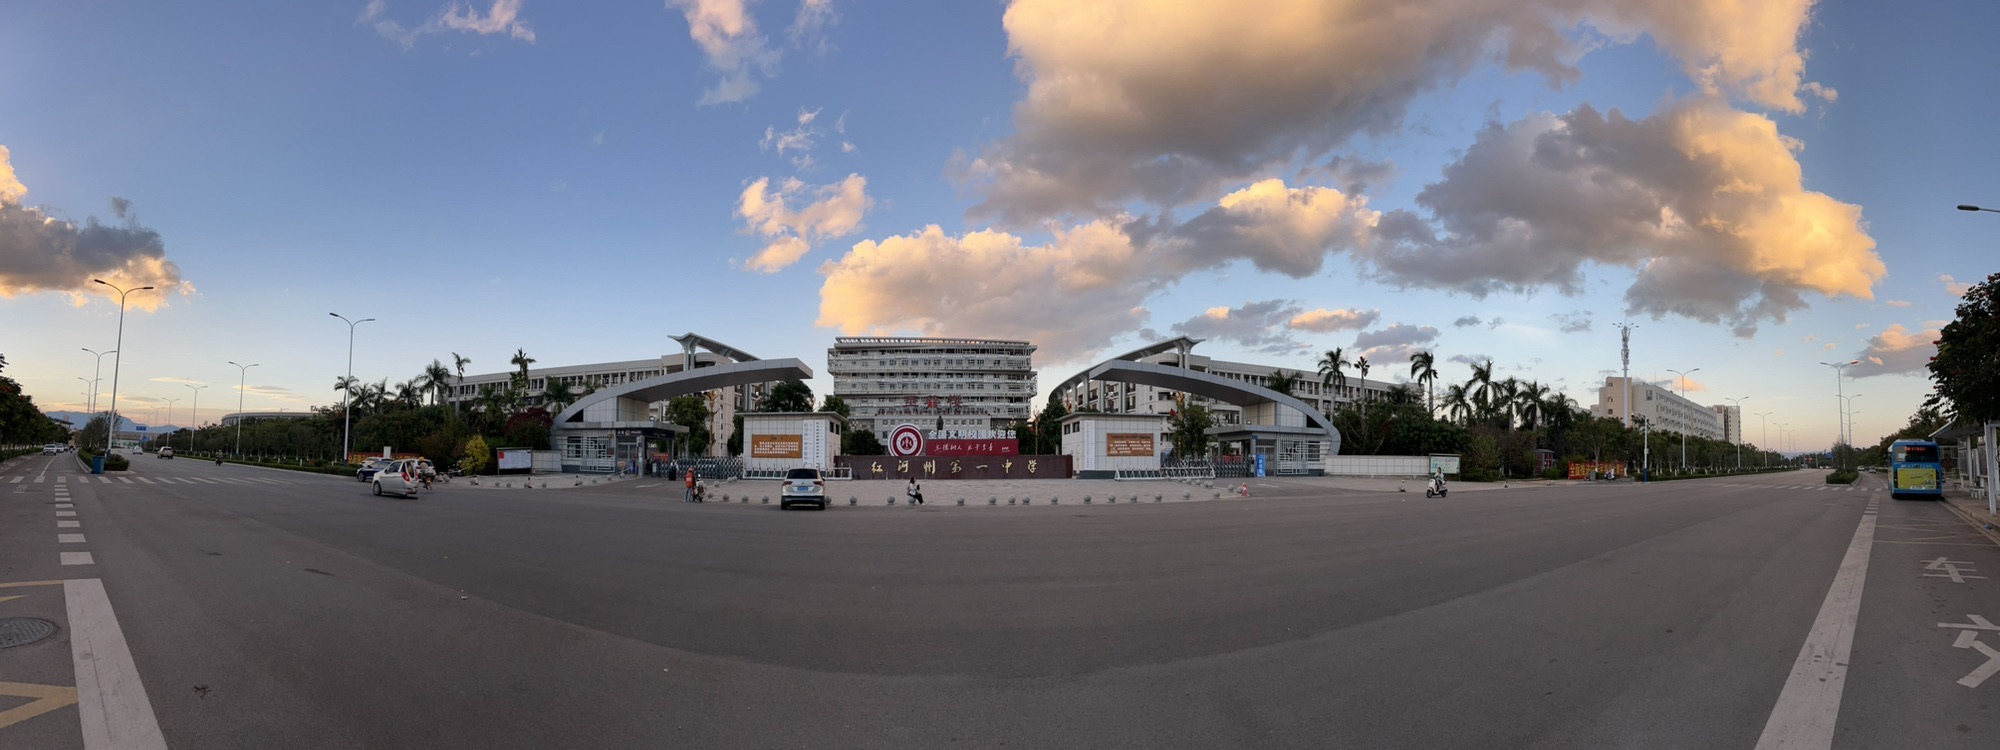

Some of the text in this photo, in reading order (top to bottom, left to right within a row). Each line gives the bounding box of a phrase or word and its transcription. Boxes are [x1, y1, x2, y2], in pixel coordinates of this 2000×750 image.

[928, 430, 1017, 440] 全国文明校园欢迎您
[871, 459, 1037, 474] 红河州第一中学
